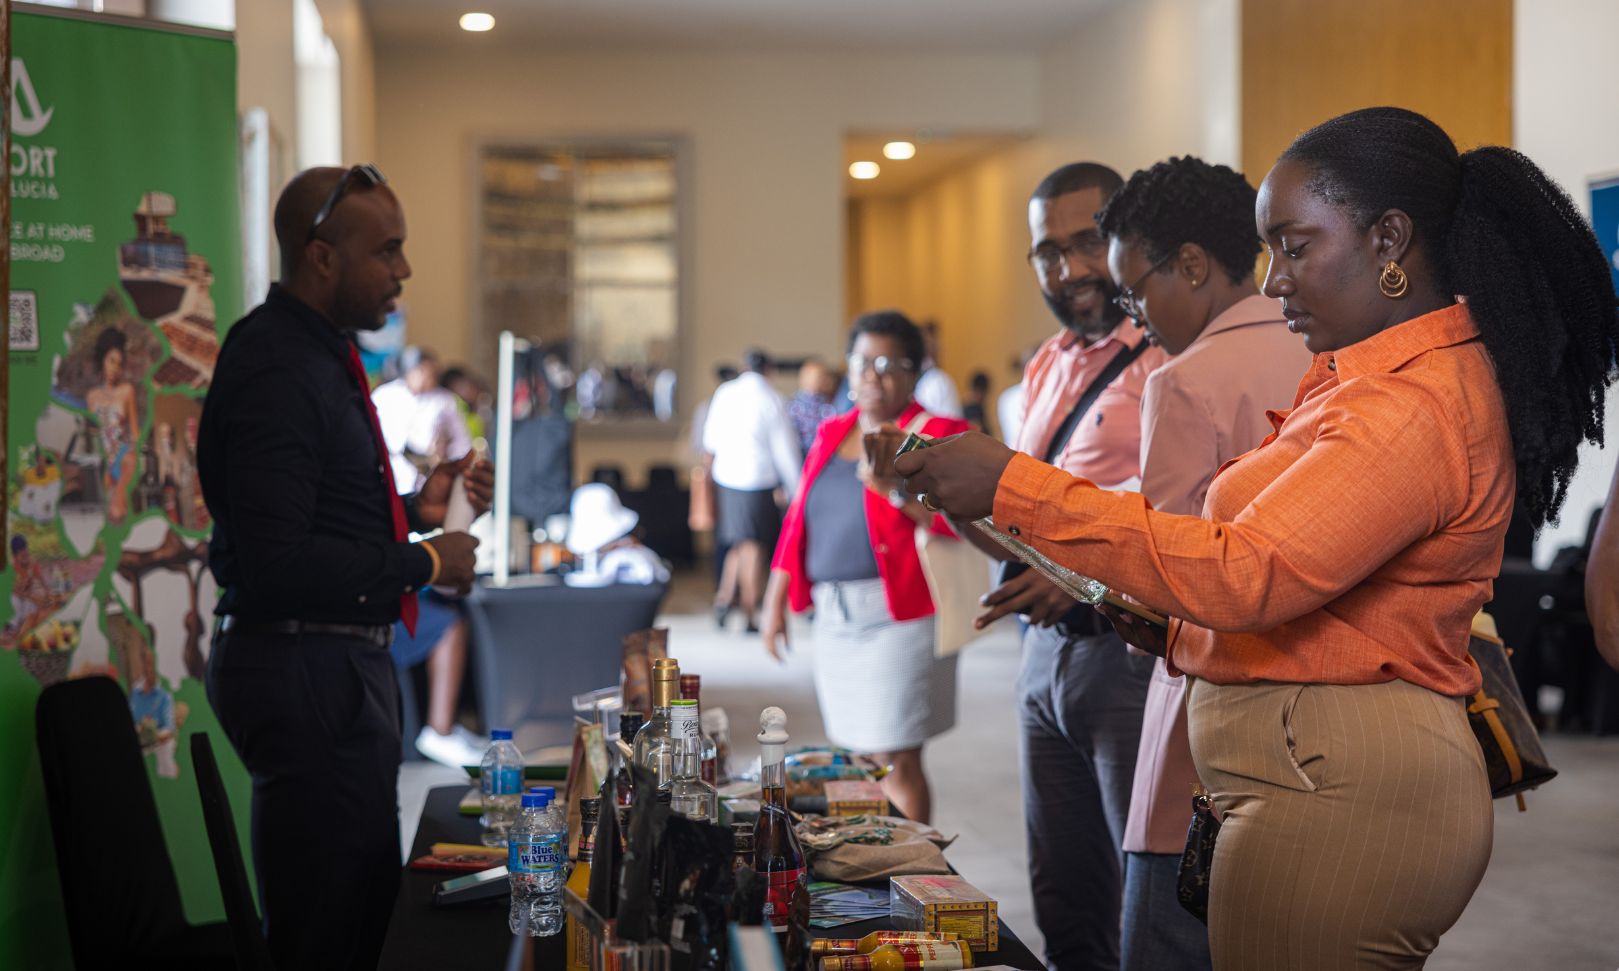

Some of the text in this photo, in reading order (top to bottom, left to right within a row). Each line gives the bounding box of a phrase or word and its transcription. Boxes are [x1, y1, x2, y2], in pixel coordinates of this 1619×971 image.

[27, 222, 45, 239] AT
[48, 223, 95, 242] HOME
[531, 845, 553, 855] Blue
[521, 853, 559, 865] WATERS
